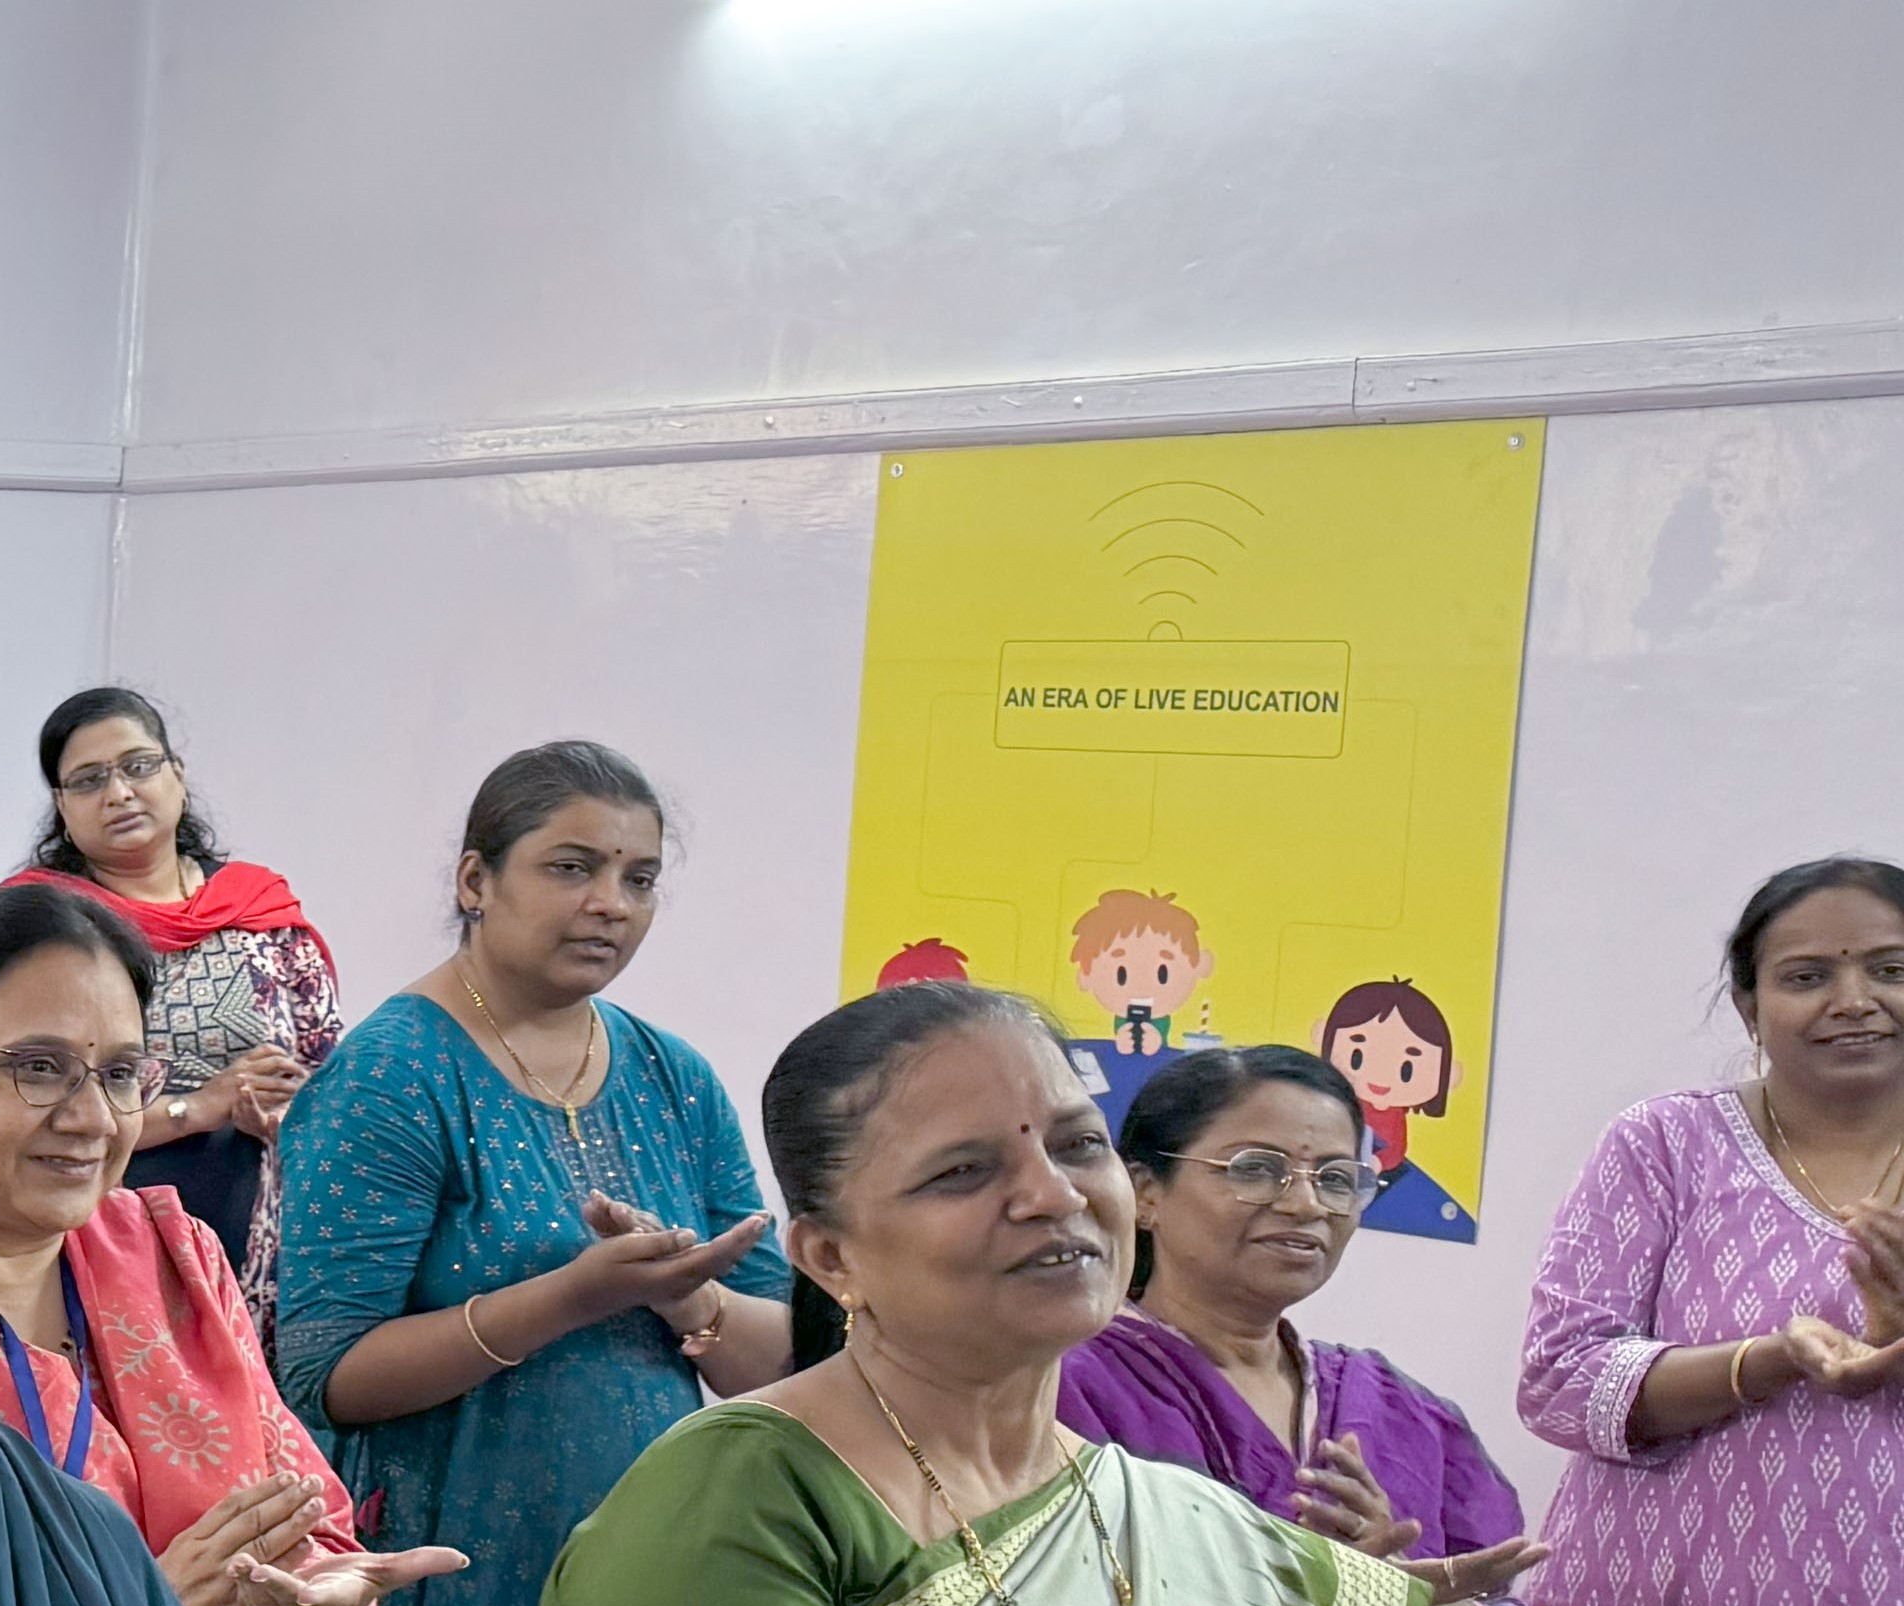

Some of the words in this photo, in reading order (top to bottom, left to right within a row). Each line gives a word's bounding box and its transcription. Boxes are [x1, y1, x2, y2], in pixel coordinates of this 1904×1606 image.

[1004, 687, 1036, 708] AN
[1042, 687, 1089, 708] ERA
[1095, 688, 1128, 709] OF
[1134, 688, 1187, 710] LIVE
[1192, 689, 1340, 713] EDUCATION
